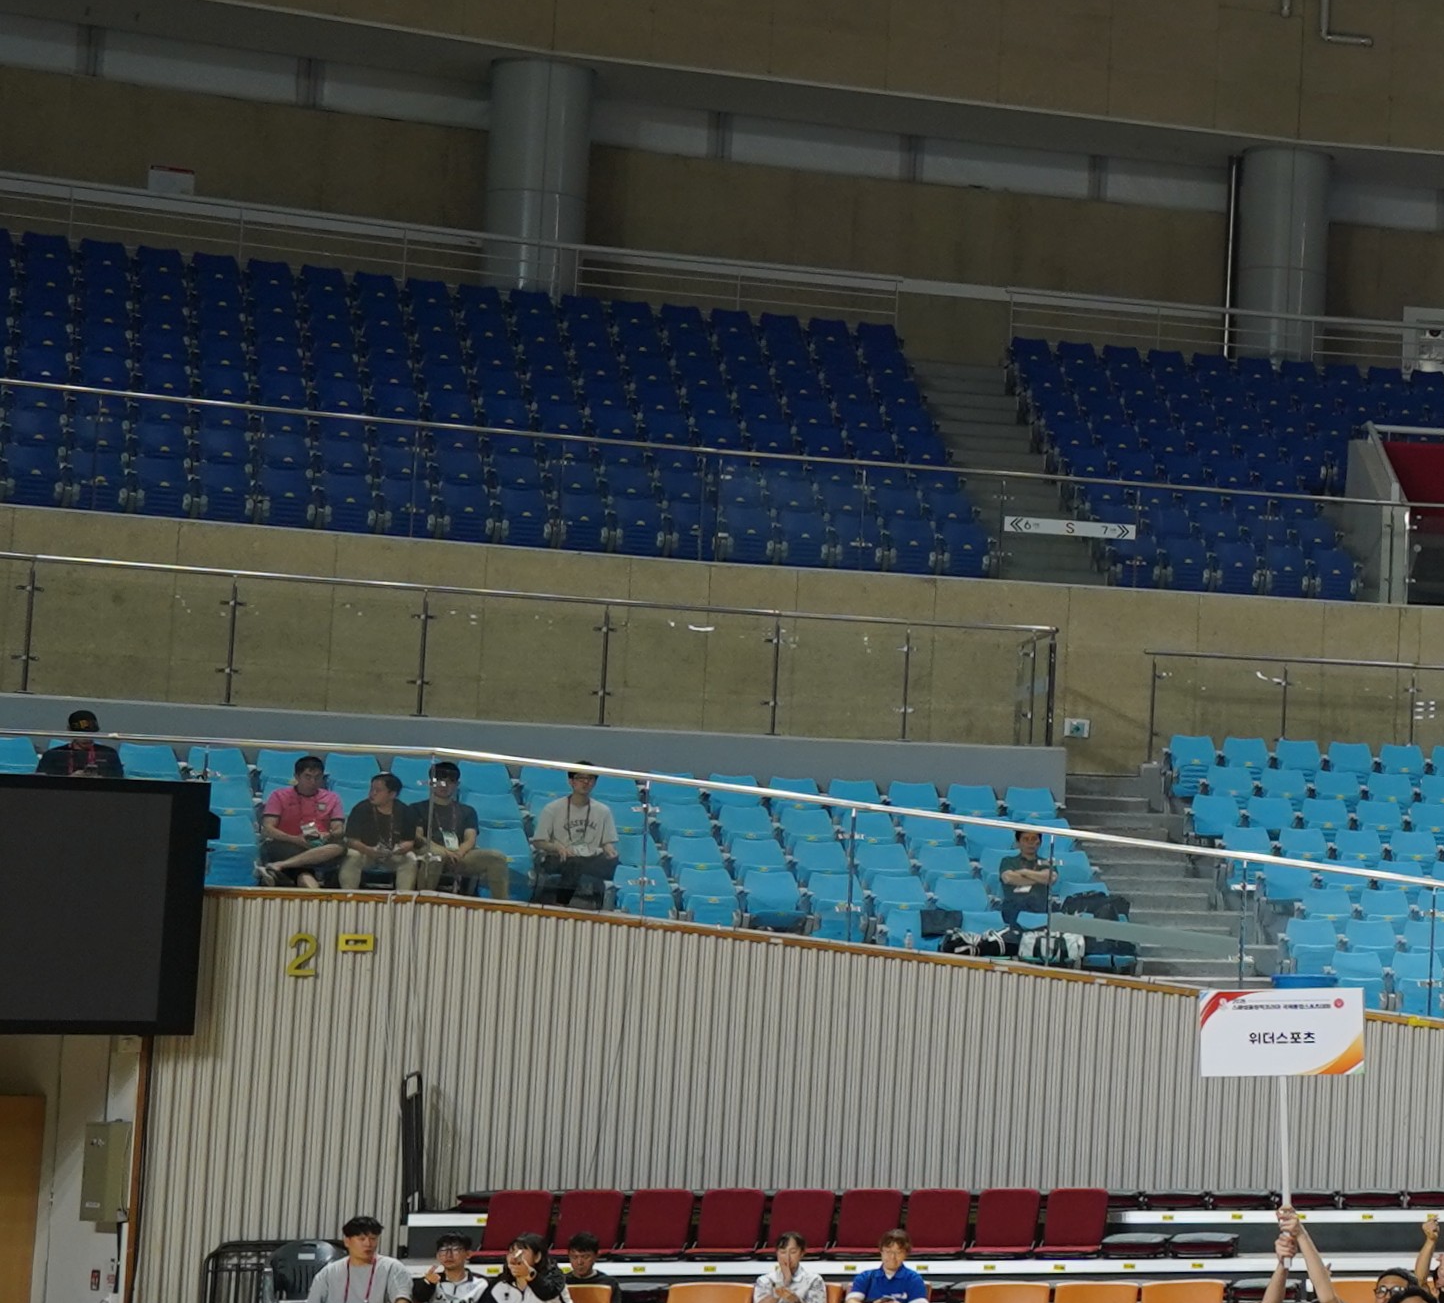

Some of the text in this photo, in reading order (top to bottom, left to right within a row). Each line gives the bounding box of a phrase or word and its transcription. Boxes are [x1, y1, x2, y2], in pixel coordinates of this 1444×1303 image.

[1066, 522, 1075, 534] S
[287, 933, 317, 977] 2
[1249, 1032, 1316, 1044] 위더스포츠
